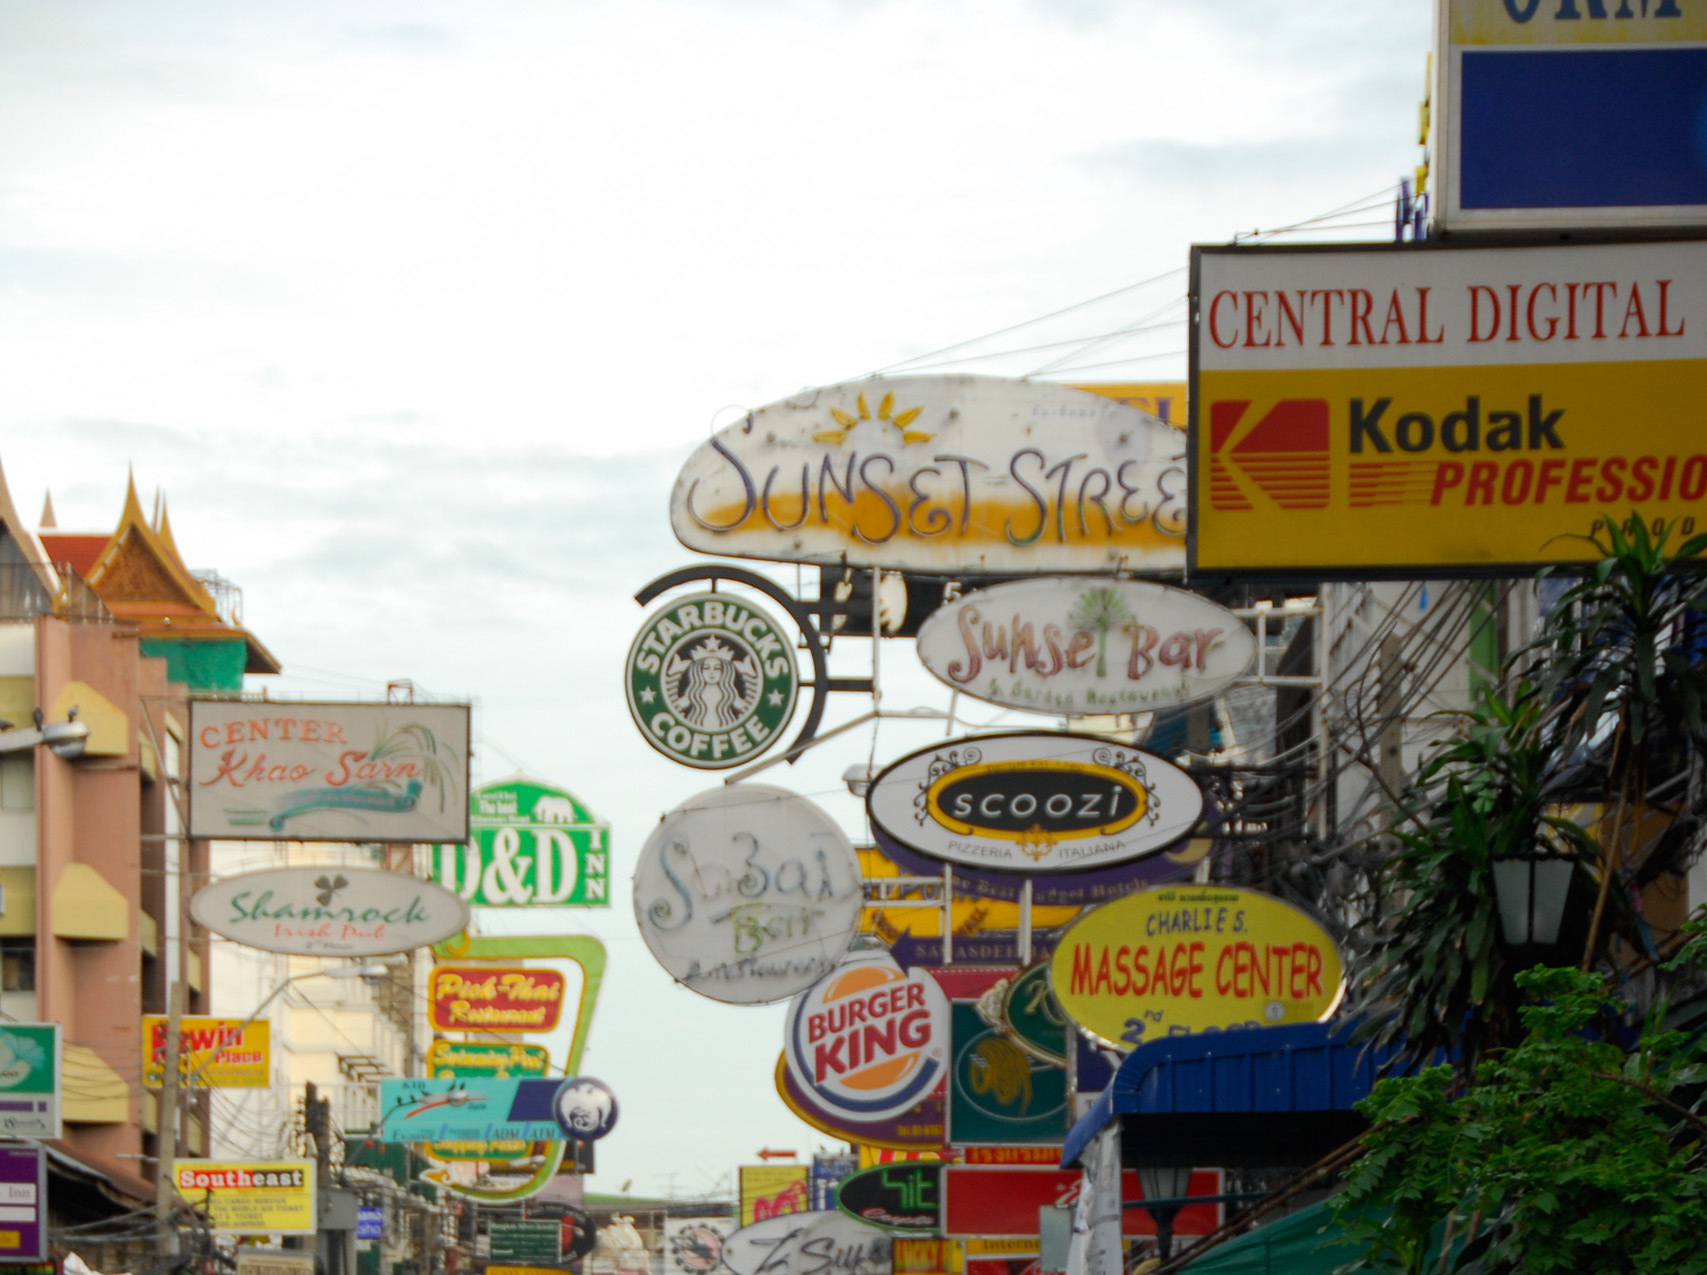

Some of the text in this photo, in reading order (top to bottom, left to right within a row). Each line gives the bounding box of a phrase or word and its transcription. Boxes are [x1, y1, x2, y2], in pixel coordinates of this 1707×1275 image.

[1209, 280, 1686, 349] CENTRAL DIGITAL
[1349, 394, 1567, 453] Kodak
[1004, 446, 1188, 547] STREE
[636, 601, 789, 680] STARBUCKS
[1121, 621, 1224, 680] Bar
[200, 717, 347, 749] CENTER
[651, 711, 771, 760] COFFEE
[199, 749, 421, 787] Khao Sarn
[584, 828, 606, 900] INN
[947, 838, 1127, 860] PIZZERIA ITALIANA
[228, 890, 430, 924] Shamrock
[1091, 877, 1150, 898] Hotels
[273, 922, 386, 940] Irish Pub
[1146, 907, 1228, 937] CHARLIE
[1071, 941, 1324, 999] MASSAGE CENTER
[808, 982, 926, 1044] BURGER
[214, 1051, 262, 1066] Place
[814, 1009, 932, 1084] KING
[180, 1169, 304, 1189] Southeast
